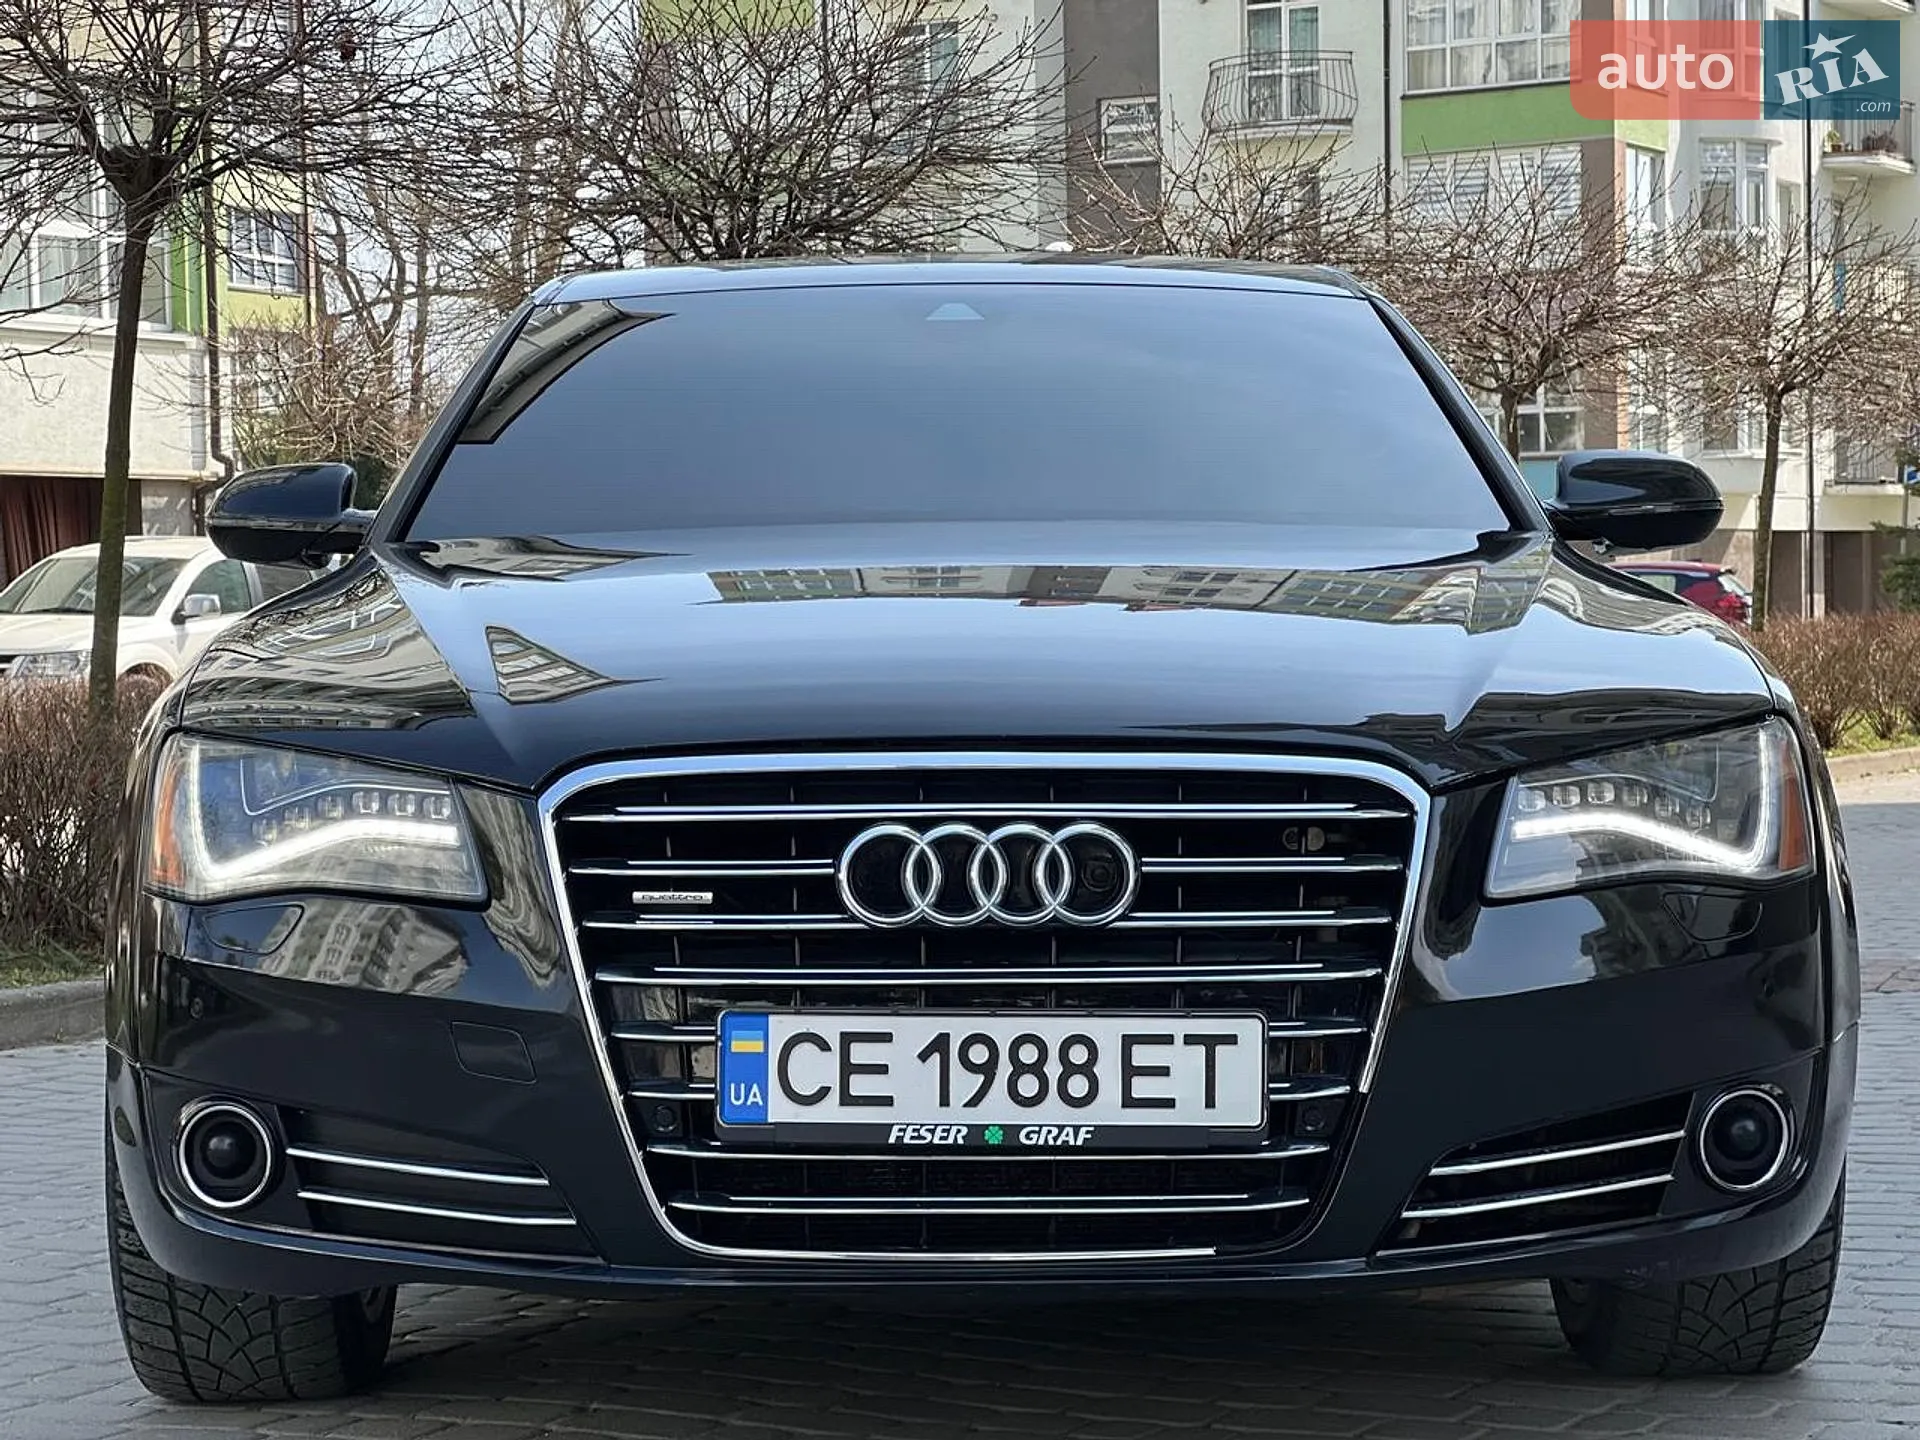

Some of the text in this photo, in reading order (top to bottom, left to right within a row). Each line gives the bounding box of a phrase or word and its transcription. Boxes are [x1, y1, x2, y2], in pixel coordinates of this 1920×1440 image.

[777, 1031, 1239, 1109] CE 1988 ET
[730, 1082, 763, 1106] UA
[888, 1125, 1095, 1146] FESER GRAF
